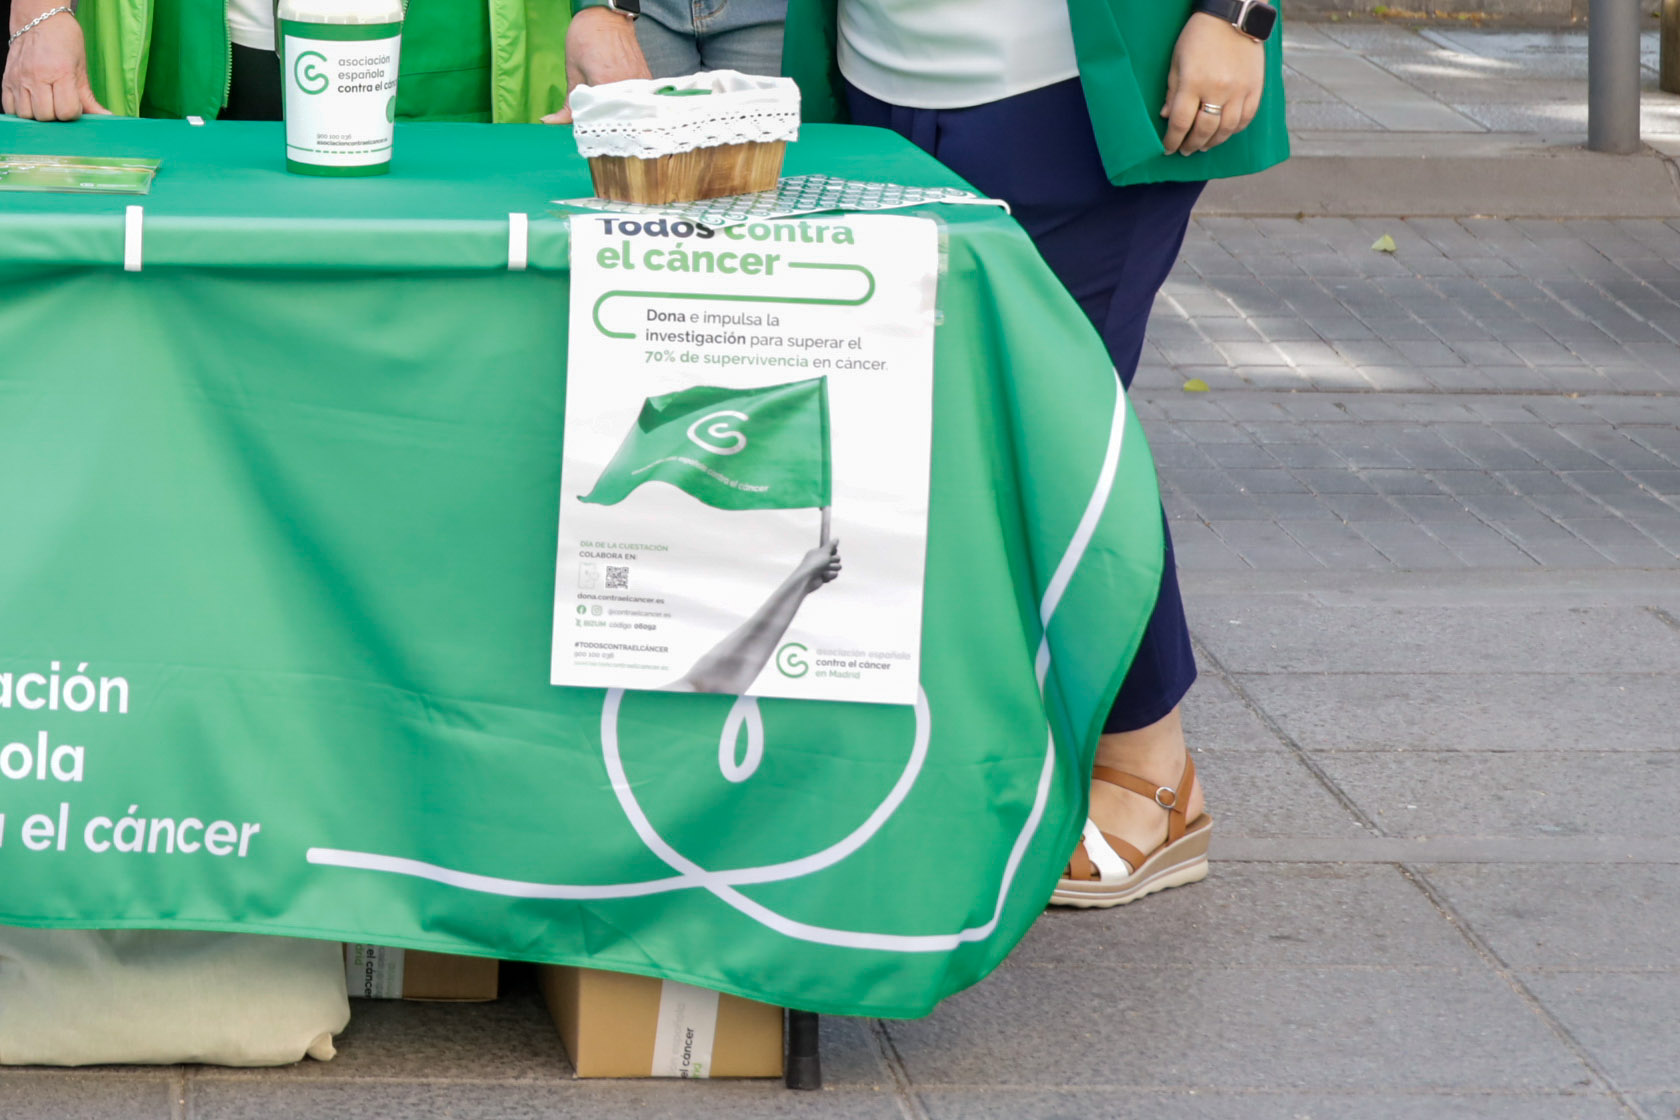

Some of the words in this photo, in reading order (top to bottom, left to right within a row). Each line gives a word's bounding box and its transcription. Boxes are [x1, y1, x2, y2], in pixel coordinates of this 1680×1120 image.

[338, 54, 390, 67] asociación
[338, 69, 384, 82] española
[338, 84, 373, 93] contra
[375, 81, 383, 91] el
[596, 218, 715, 239] Todos
[724, 220, 854, 245] contra
[596, 240, 635, 269] el
[643, 242, 781, 275] cáncer
[646, 309, 686, 323] Dona
[690, 312, 699, 323] e
[704, 311, 762, 327] impulsa
[766, 313, 780, 327] la
[646, 329, 746, 347] investigación
[750, 335, 783, 348] para
[787, 336, 844, 351] superar
[848, 336, 862, 350] el
[644, 350, 676, 363] 70%
[680, 350, 699, 363] de
[704, 352, 808, 368] supervivencia
[812, 357, 831, 368] en
[835, 356, 888, 371] cáncer.
[579, 551, 623, 559] COLABORA
[816, 659, 846, 667] contra
[859, 660, 891, 670] cáncer
[21, 802, 70, 851] el
[84, 805, 260, 858] cáncer
[366, 949, 376, 959] el
[680, 1027, 694, 1066] cáncer
